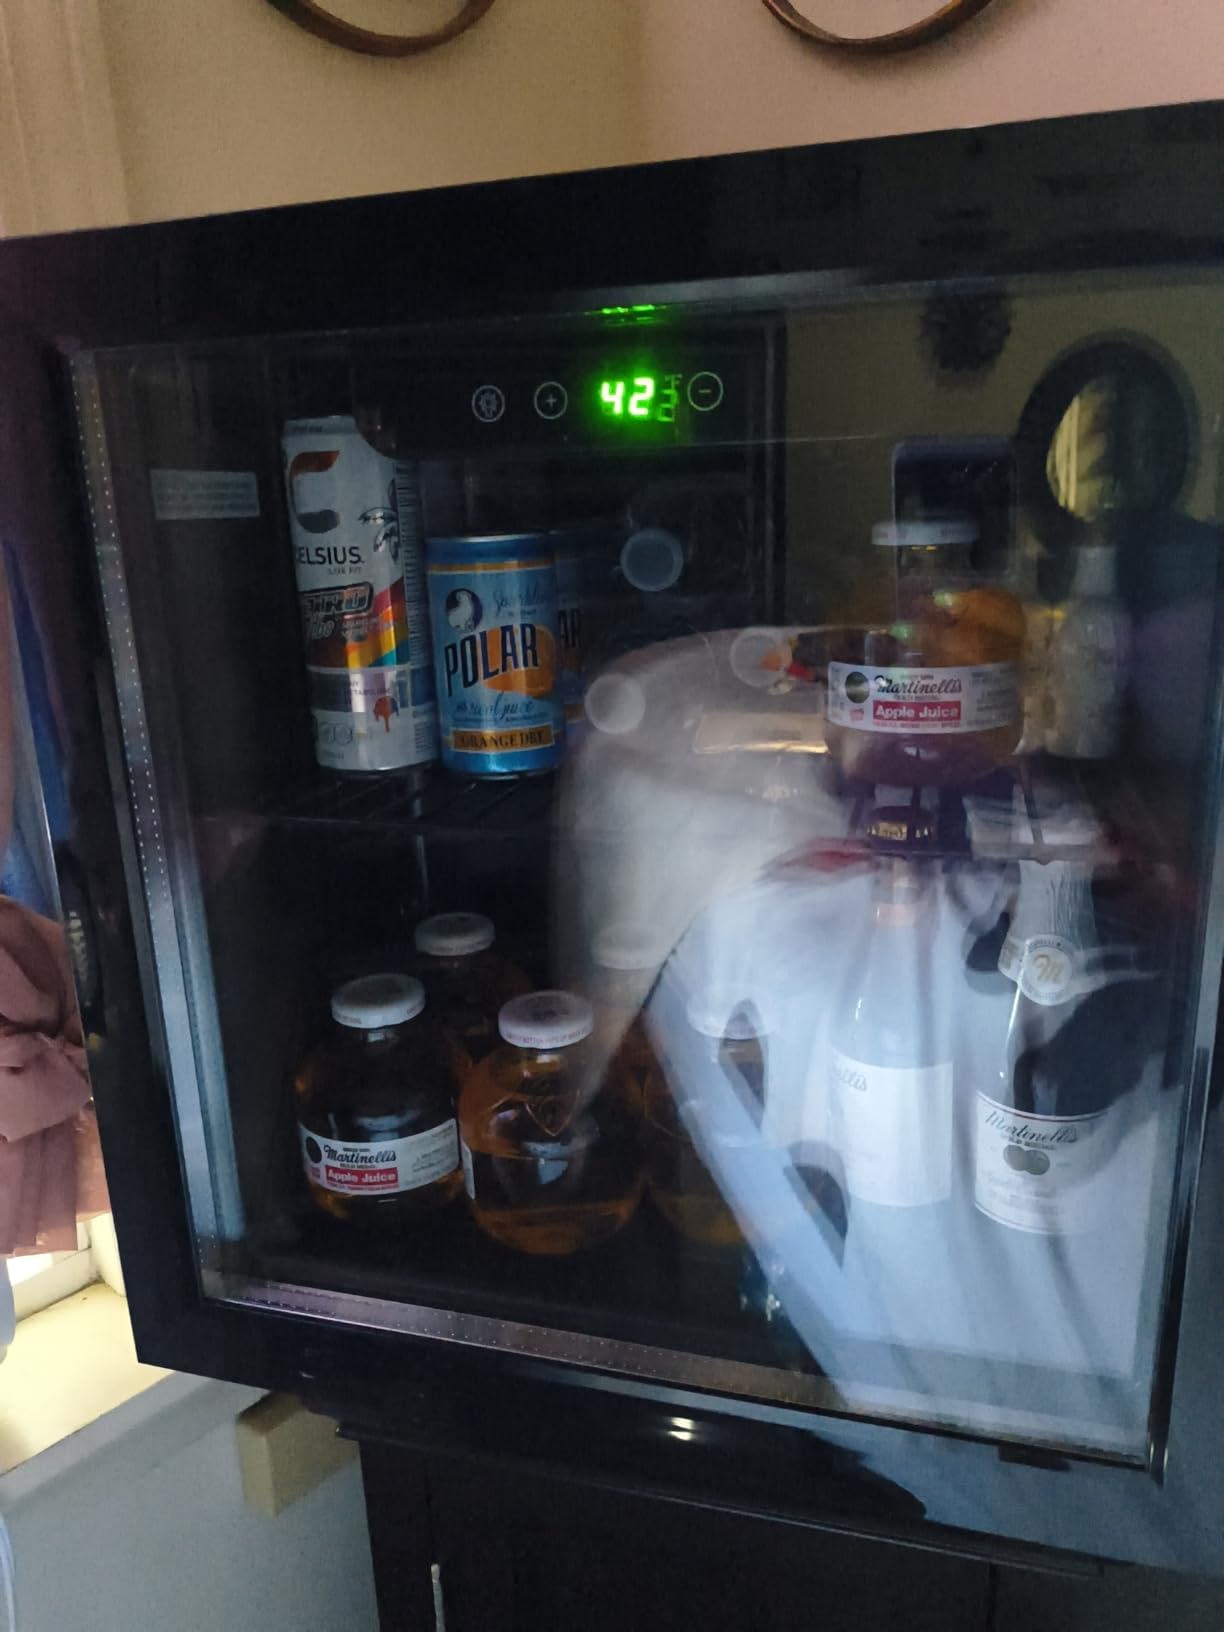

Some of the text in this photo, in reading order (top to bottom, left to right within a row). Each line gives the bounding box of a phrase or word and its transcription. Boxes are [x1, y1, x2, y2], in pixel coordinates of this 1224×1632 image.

[600, 376, 655, 417] 42
[297, 546, 363, 565] ELSIUS
[444, 623, 540, 697] POLAR
[875, 704, 916, 719] Apple
[918, 705, 959, 718] Juice
[327, 1168, 359, 1184] Apple
[361, 1171, 396, 1184] Juice
